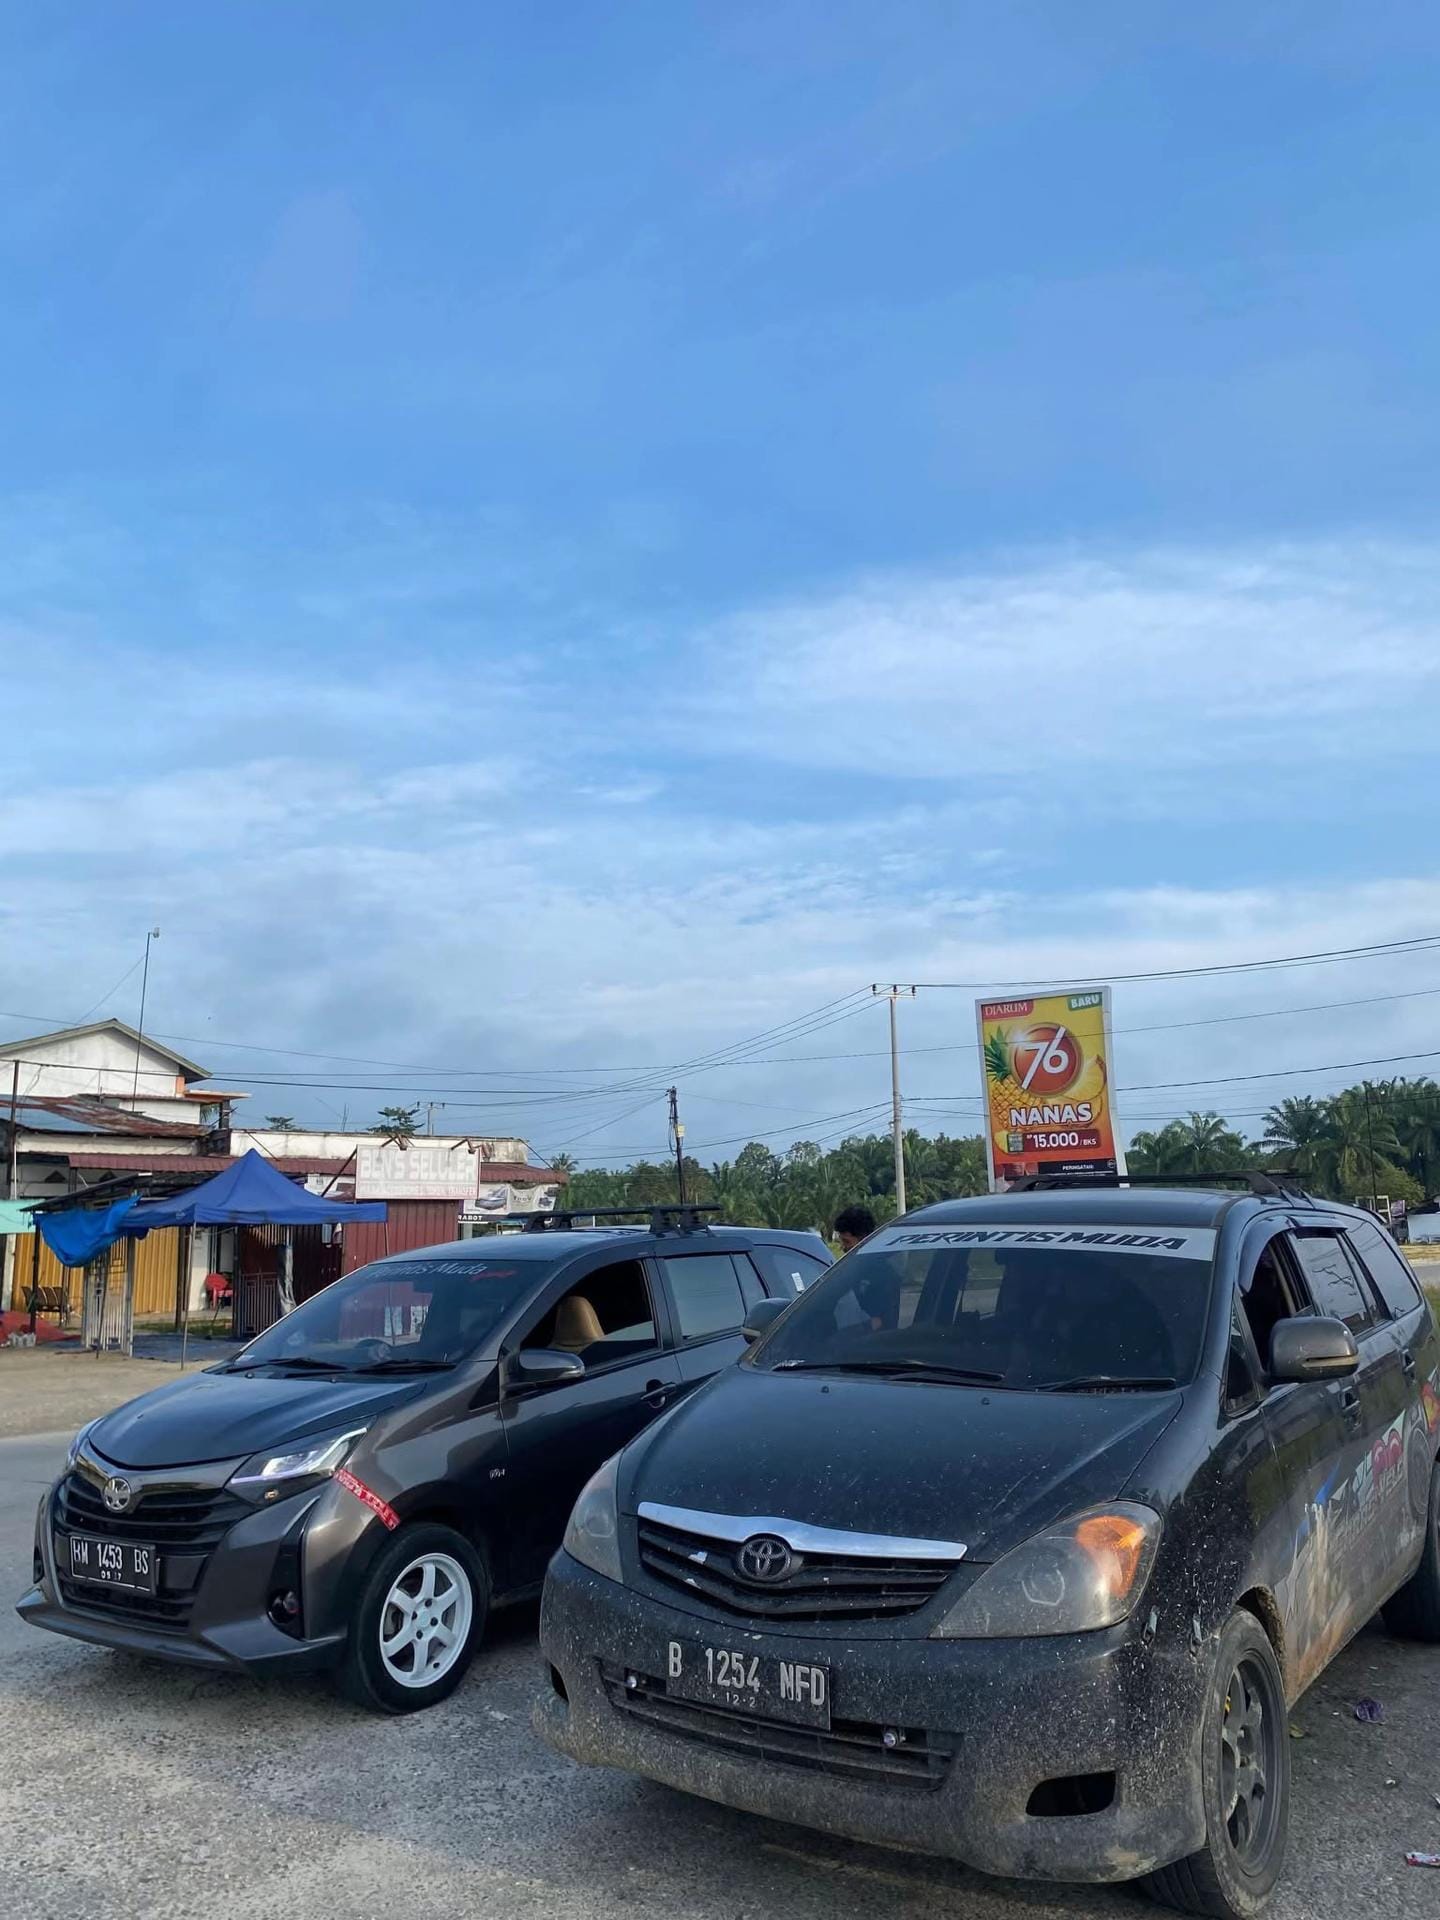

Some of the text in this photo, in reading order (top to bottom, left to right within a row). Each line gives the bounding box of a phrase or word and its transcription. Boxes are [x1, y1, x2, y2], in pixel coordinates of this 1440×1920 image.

[1071, 994, 1099, 1009] BARU
[1020, 1025, 1069, 1090] 76
[1010, 1102, 1092, 1127] NANAS
[1033, 1132, 1079, 1148] 15.000
[886, 1231, 1188, 1250] PERINTIS MUDA
[429, 1262, 488, 1275] Muda
[73, 1540, 149, 1575] BM 1453 BS
[668, 1641, 826, 1706] B 1254 NFD
